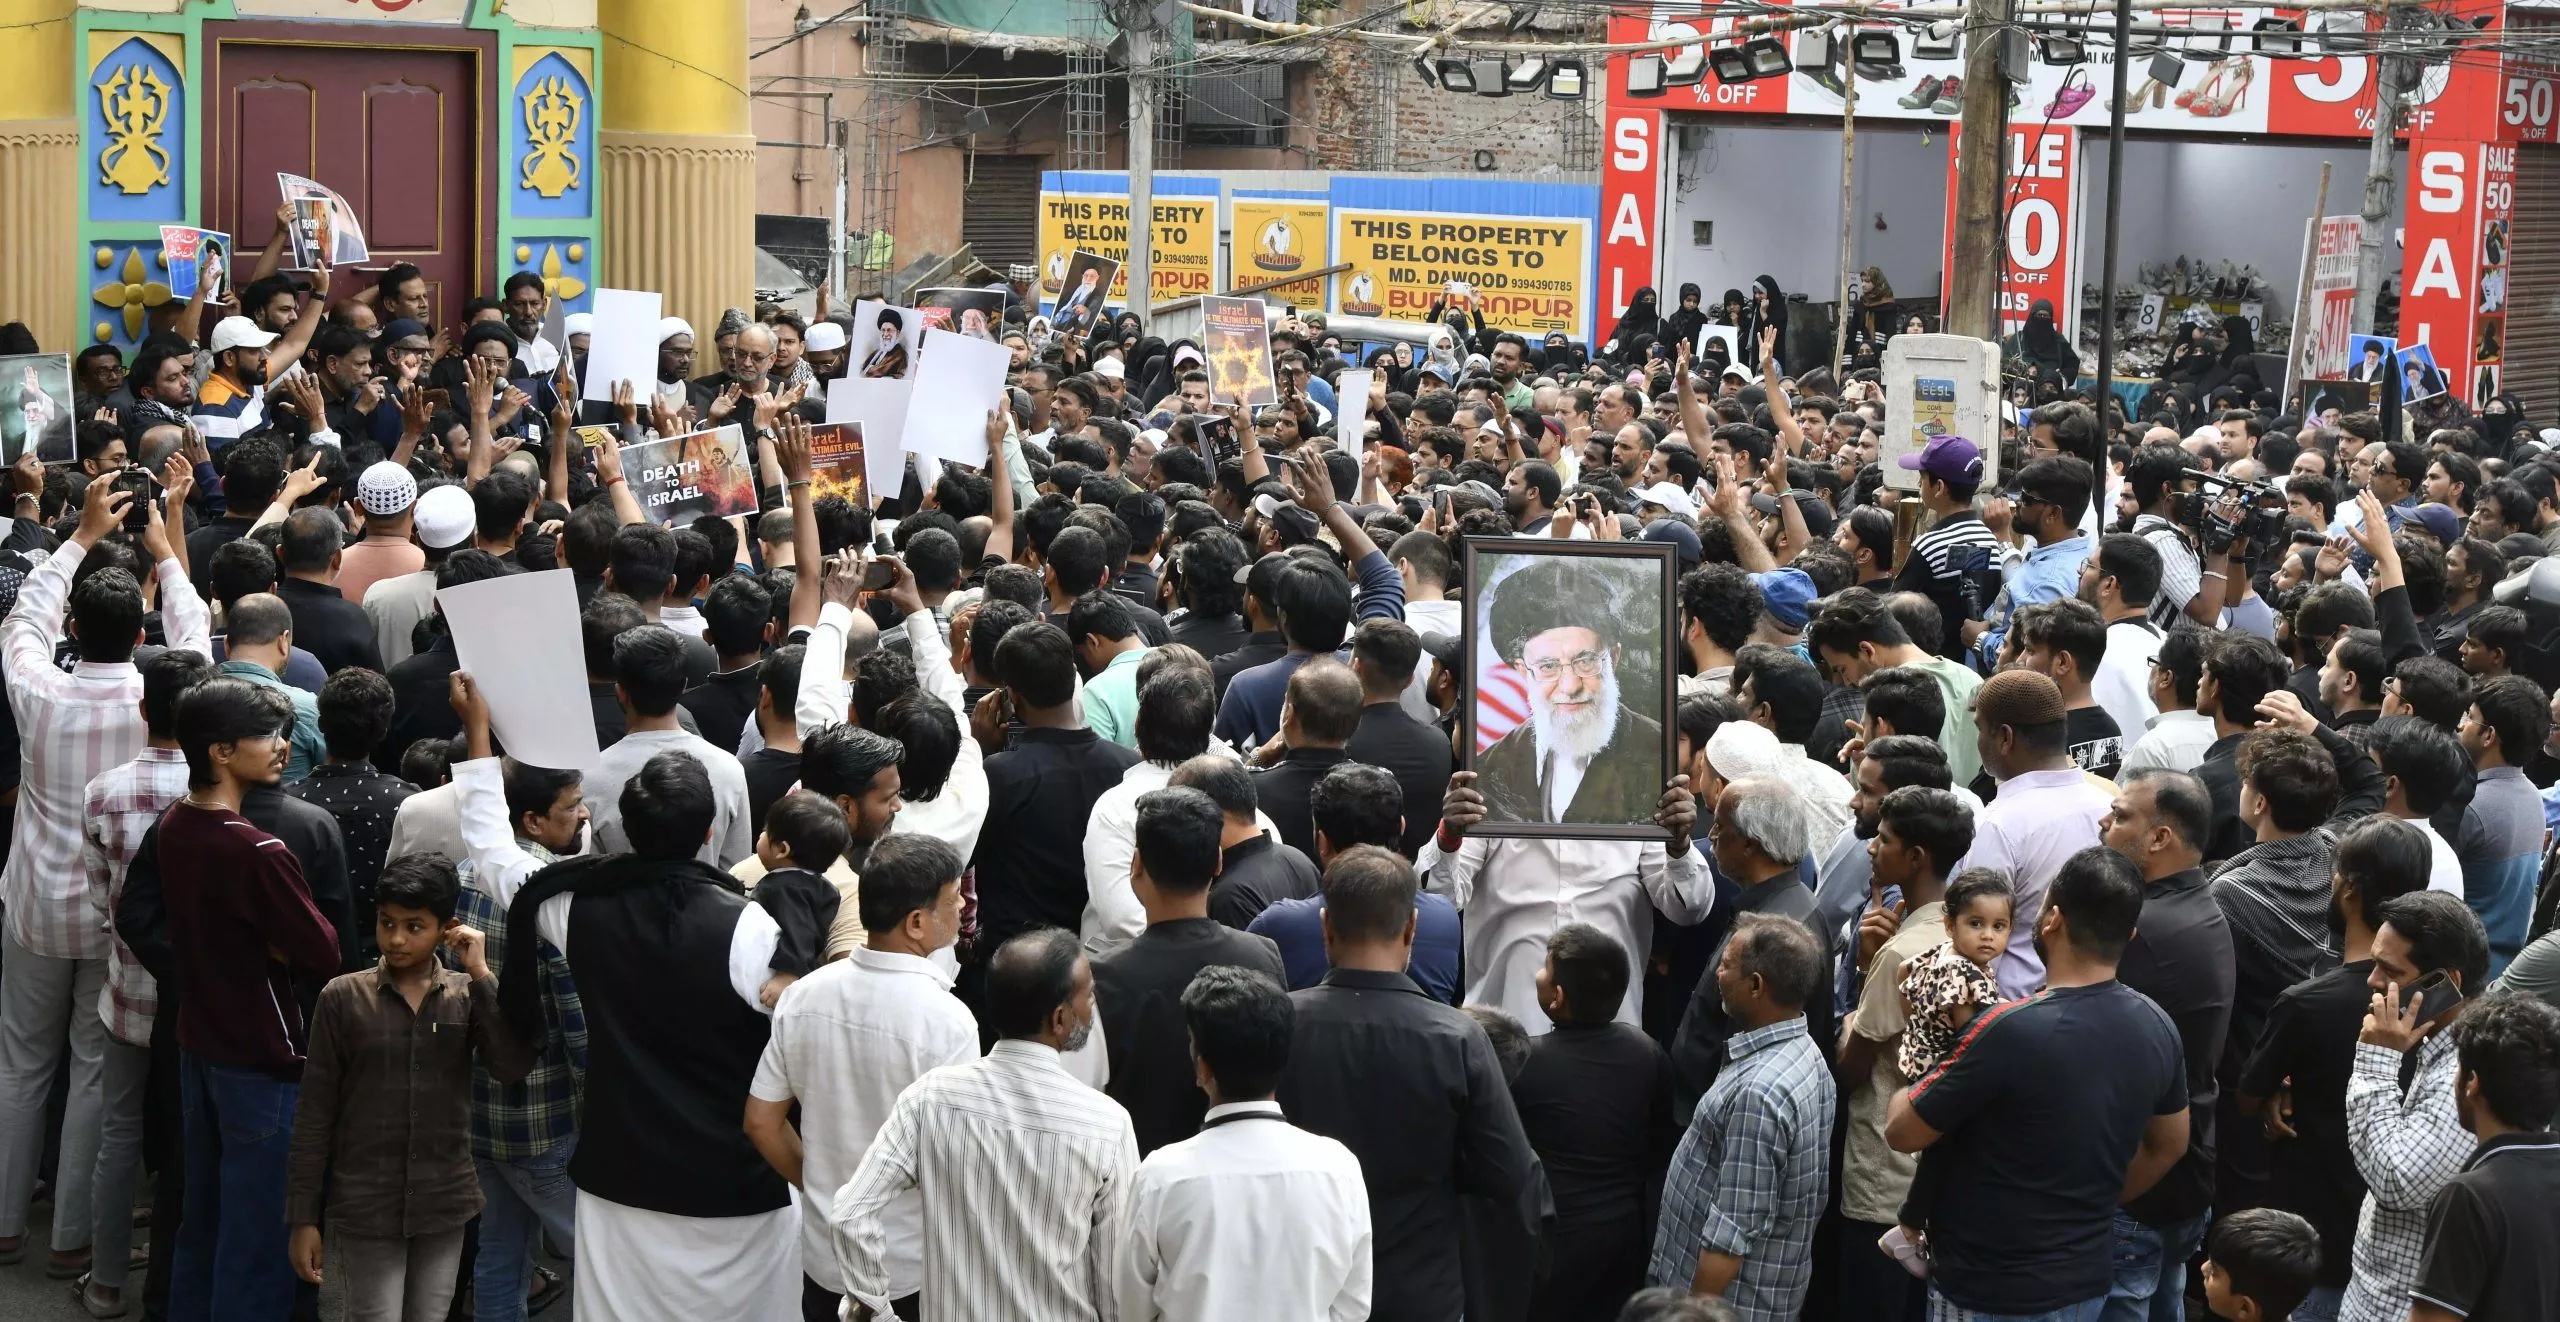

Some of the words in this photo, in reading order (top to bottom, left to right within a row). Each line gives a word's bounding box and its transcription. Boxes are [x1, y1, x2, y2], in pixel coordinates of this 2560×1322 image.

[1716, 84, 1757, 105] OFF
[2503, 78, 2553, 126] 50
[2396, 110, 2434, 132] FF
[2531, 128, 2547, 139] OFF
[2487, 146, 2515, 173] SALE
[2009, 183, 2039, 195] AT
[2485, 181, 2512, 210] 50
[1048, 202, 1092, 220] THIS
[1098, 204, 1205, 223] PRERTY
[1064, 223, 1155, 242] BELON
[1161, 227, 1188, 245] TO
[1350, 220, 1412, 240] THIS
[1421, 223, 1569, 247] PROPERTY
[2007, 197, 2061, 271] 0
[2318, 222, 2363, 256] EENATH
[1103, 248, 1162, 264] DAWD
[1163, 253, 1209, 265] 9394390785
[1372, 243, 1499, 267] BELONGS
[1507, 250, 1545, 269] TO
[1389, 267, 1421, 284] MD.
[1427, 269, 1508, 289] DAWOOD
[1511, 278, 1573, 292] 9394390785
[2014, 272, 2049, 284] OFF
[1993, 291, 2029, 312] DS
[2141, 304, 2155, 325] 8
[2250, 315, 2260, 332] 0
[1921, 385, 1951, 397] EESL
[811, 426, 841, 446] srael
[1923, 425, 1945, 434] GHMC
[811, 443, 843, 455] LTIMATE
[643, 459, 700, 483] DEATH
[664, 477, 680, 489] TO
